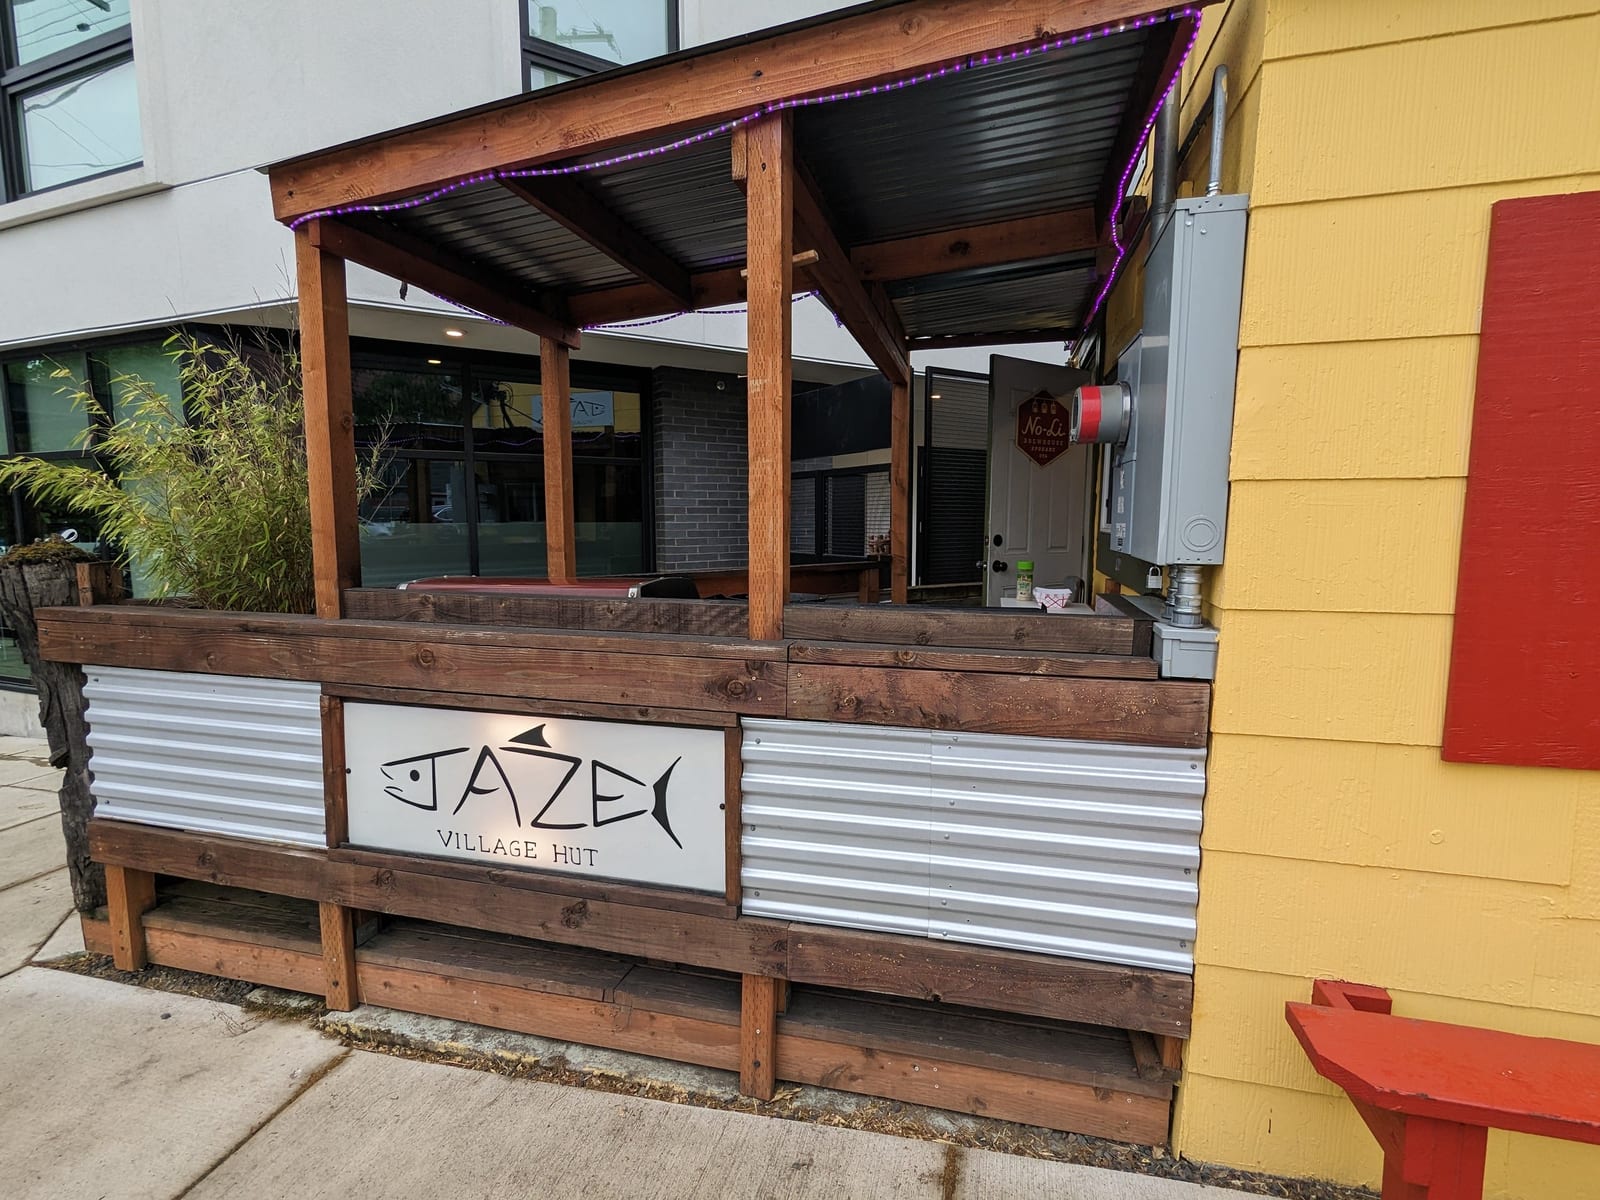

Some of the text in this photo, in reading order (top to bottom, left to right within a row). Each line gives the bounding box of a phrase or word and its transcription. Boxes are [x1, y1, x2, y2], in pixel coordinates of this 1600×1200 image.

[1021, 416, 1065, 437] No-Li
[1023, 438, 1064, 446] BREWHOUSE
[380, 745, 649, 829] JAZE
[437, 830, 599, 867] VILLAGE HUT
